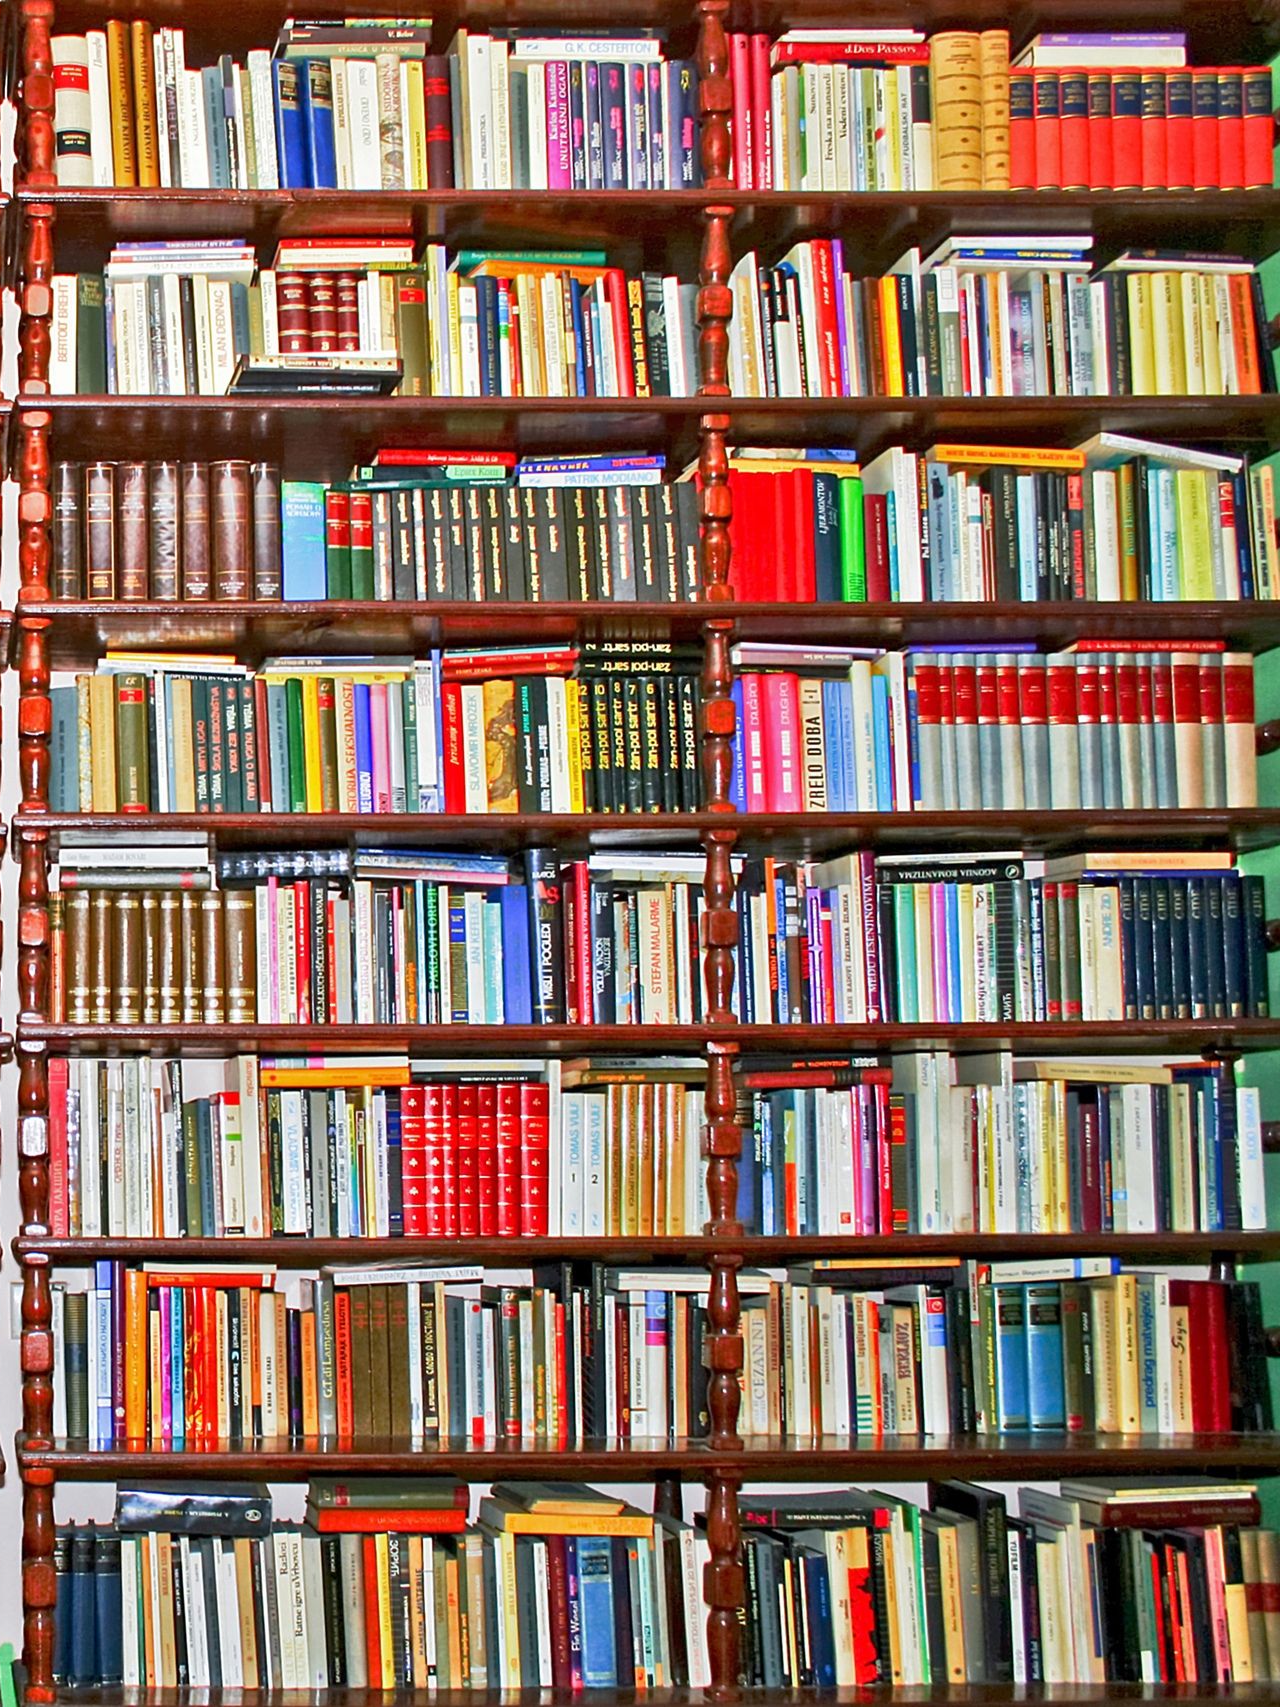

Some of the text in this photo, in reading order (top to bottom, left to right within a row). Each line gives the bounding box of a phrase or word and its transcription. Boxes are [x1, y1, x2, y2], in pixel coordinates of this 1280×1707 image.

[557, 63, 567, 98] OGANJ
[548, 63, 558, 140] Karlos Kastaneda
[824, 132, 833, 161] Freska
[806, 716, 825, 808] ZRELO DOBA
[197, 775, 207, 801] TIŠMA
[212, 774, 223, 799] TIŠMA
[541, 923, 553, 965] POGLEDI
[650, 899, 661, 994] STEFAN MALARME
[543, 975, 554, 999] MISLI
[570, 1129, 580, 1165] TOMAS
[591, 1131, 601, 1167] TOMAS
[895, 1322, 911, 1379] BERLIOZ
[1139, 1291, 1155, 1408] predrag matvejević
